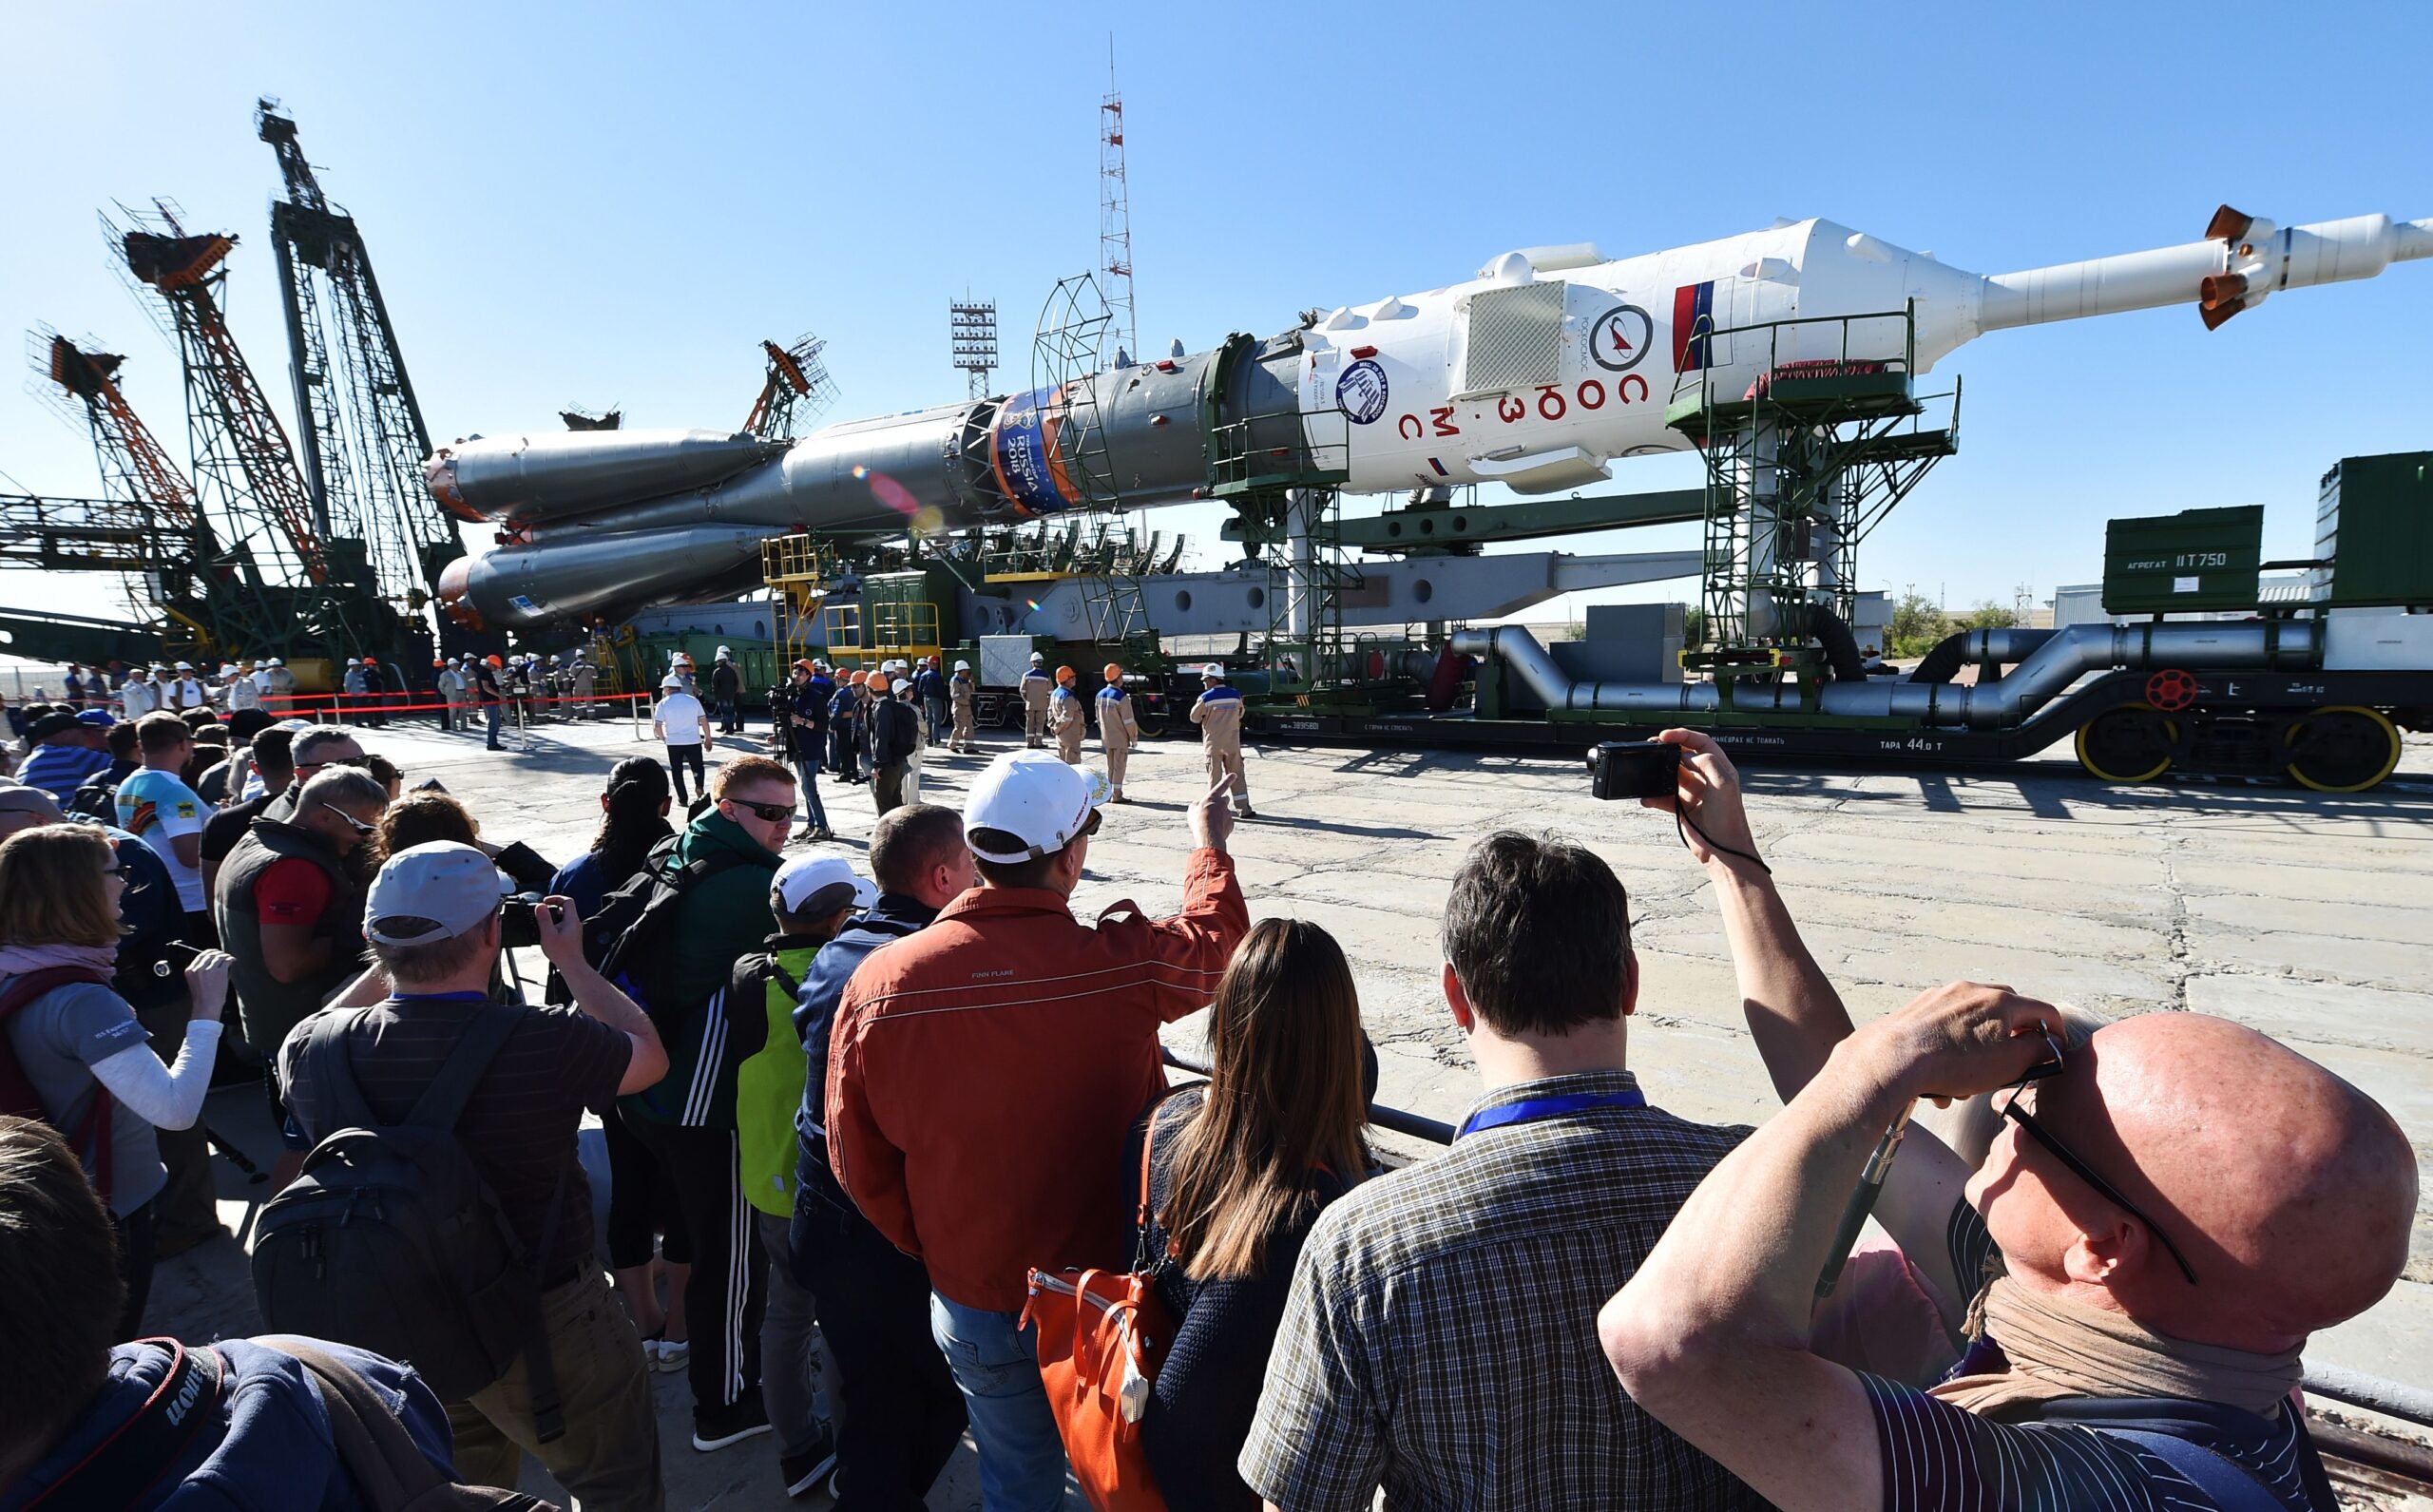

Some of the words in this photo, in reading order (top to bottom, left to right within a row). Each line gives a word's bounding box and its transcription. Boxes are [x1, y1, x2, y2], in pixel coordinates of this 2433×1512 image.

[1580, 316, 1589, 373] РОСКОСМОС
[1008, 438, 1021, 473] 2018
[1017, 435, 1039, 491] RUSSIA
[2127, 561, 2167, 569] АГРЕГАТ
[1880, 740, 1901, 750] ТАРА
